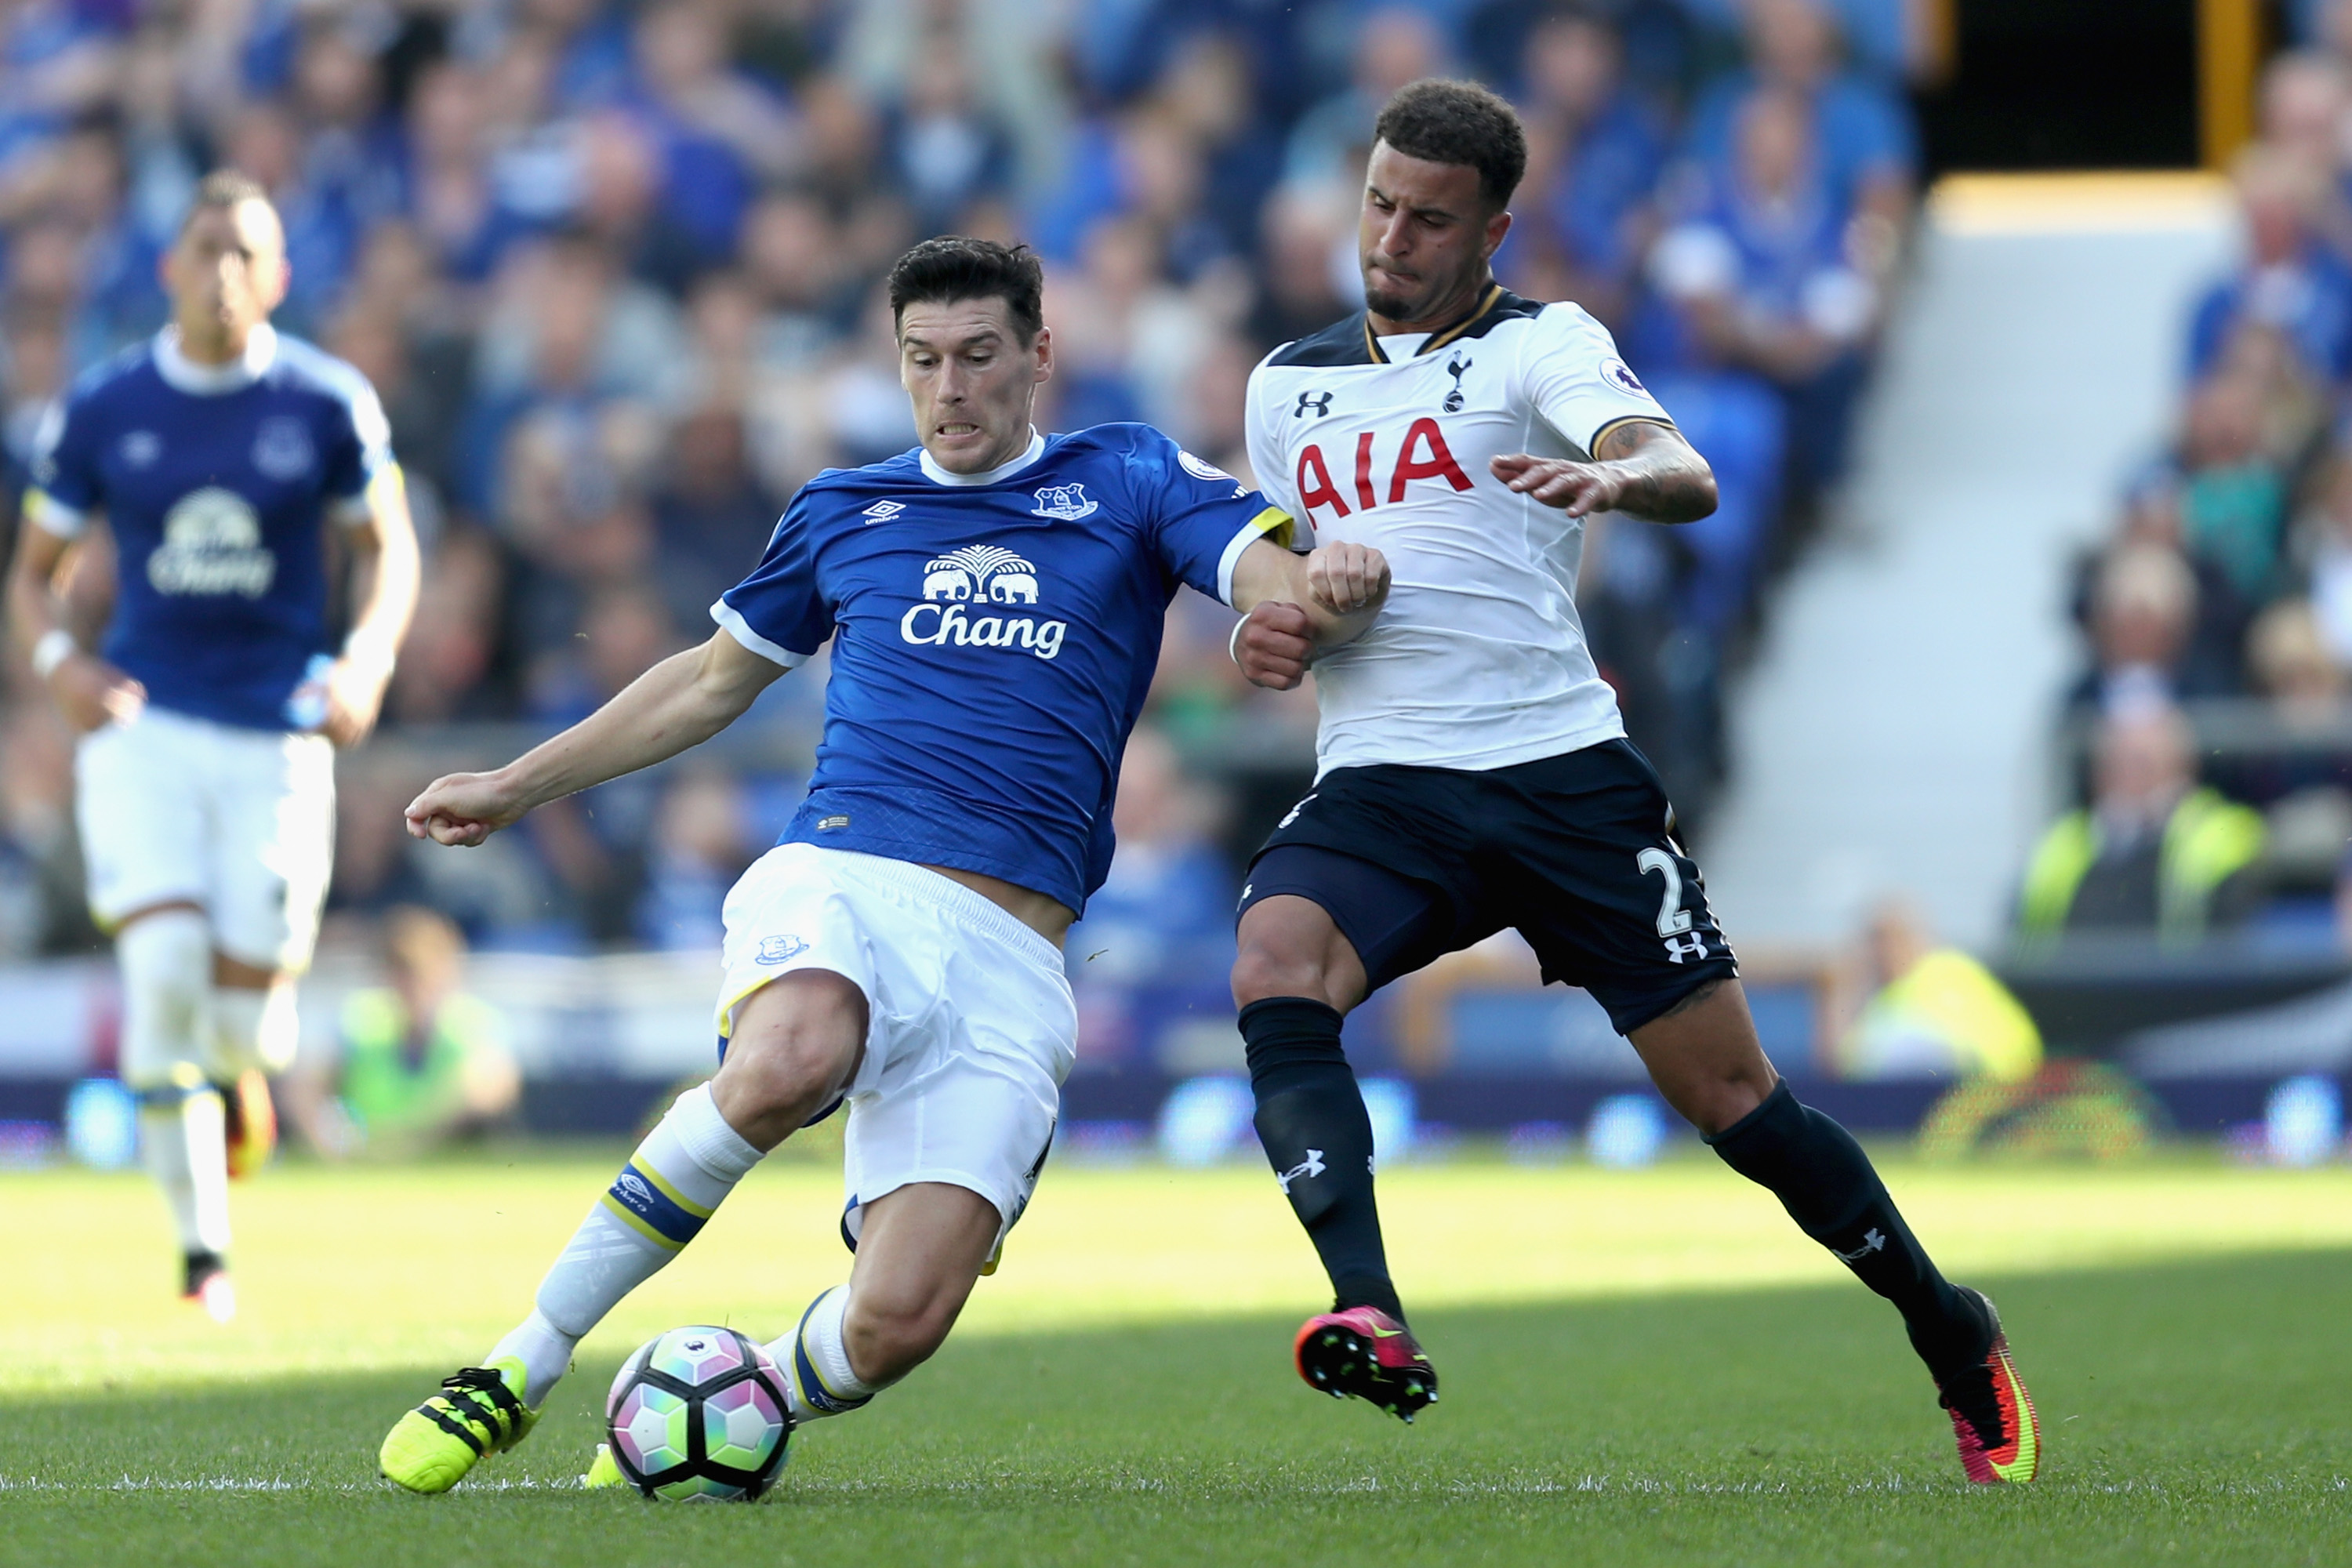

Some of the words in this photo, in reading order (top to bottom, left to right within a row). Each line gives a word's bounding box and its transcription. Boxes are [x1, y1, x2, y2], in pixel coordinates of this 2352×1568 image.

[1297, 417, 1475, 532] AIA
[865, 514, 899, 525] umbro
[901, 603, 1068, 659] Chang
[1636, 847, 1692, 938] 2
